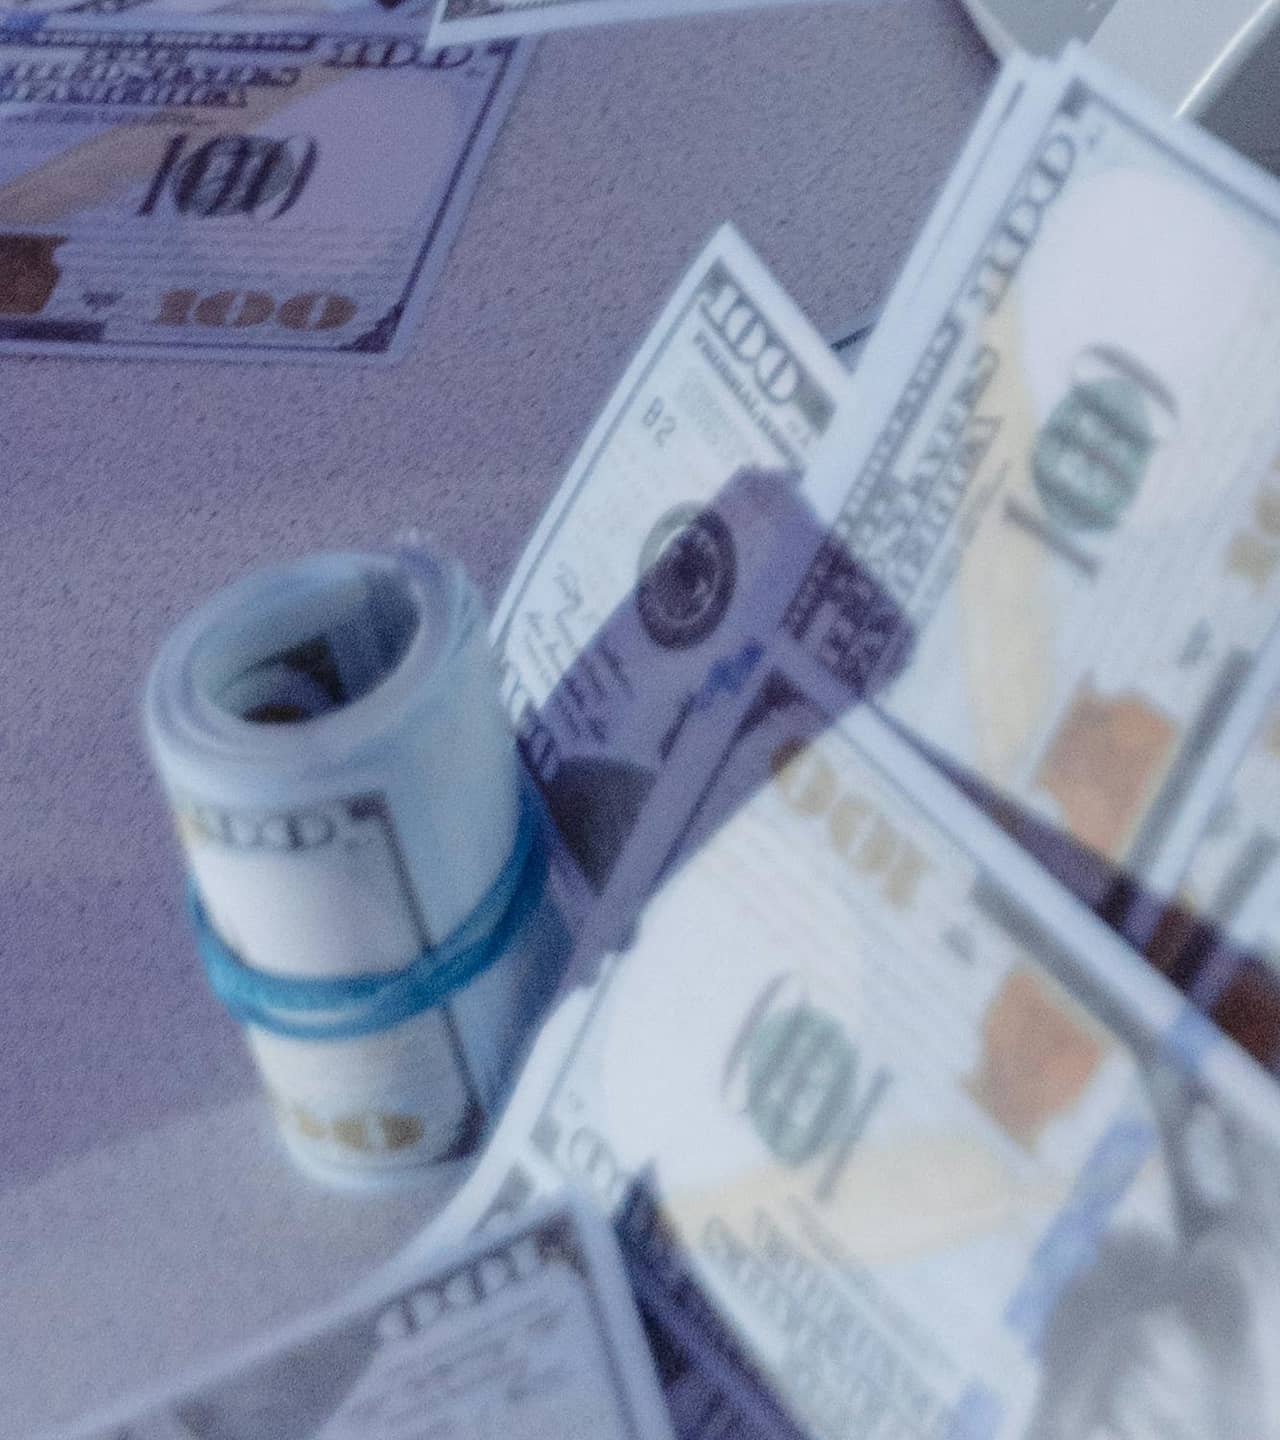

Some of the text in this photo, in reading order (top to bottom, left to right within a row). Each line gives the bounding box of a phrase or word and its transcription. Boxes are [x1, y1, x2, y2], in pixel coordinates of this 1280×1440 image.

[137, 130, 317, 224] 100
[962, 133, 1080, 317] 100
[154, 289, 358, 333] 100
[693, 274, 810, 413] 100
[691, 327, 763, 421] FEDERAL
[634, 396, 684, 449] B2
[996, 337, 1183, 582] 100
